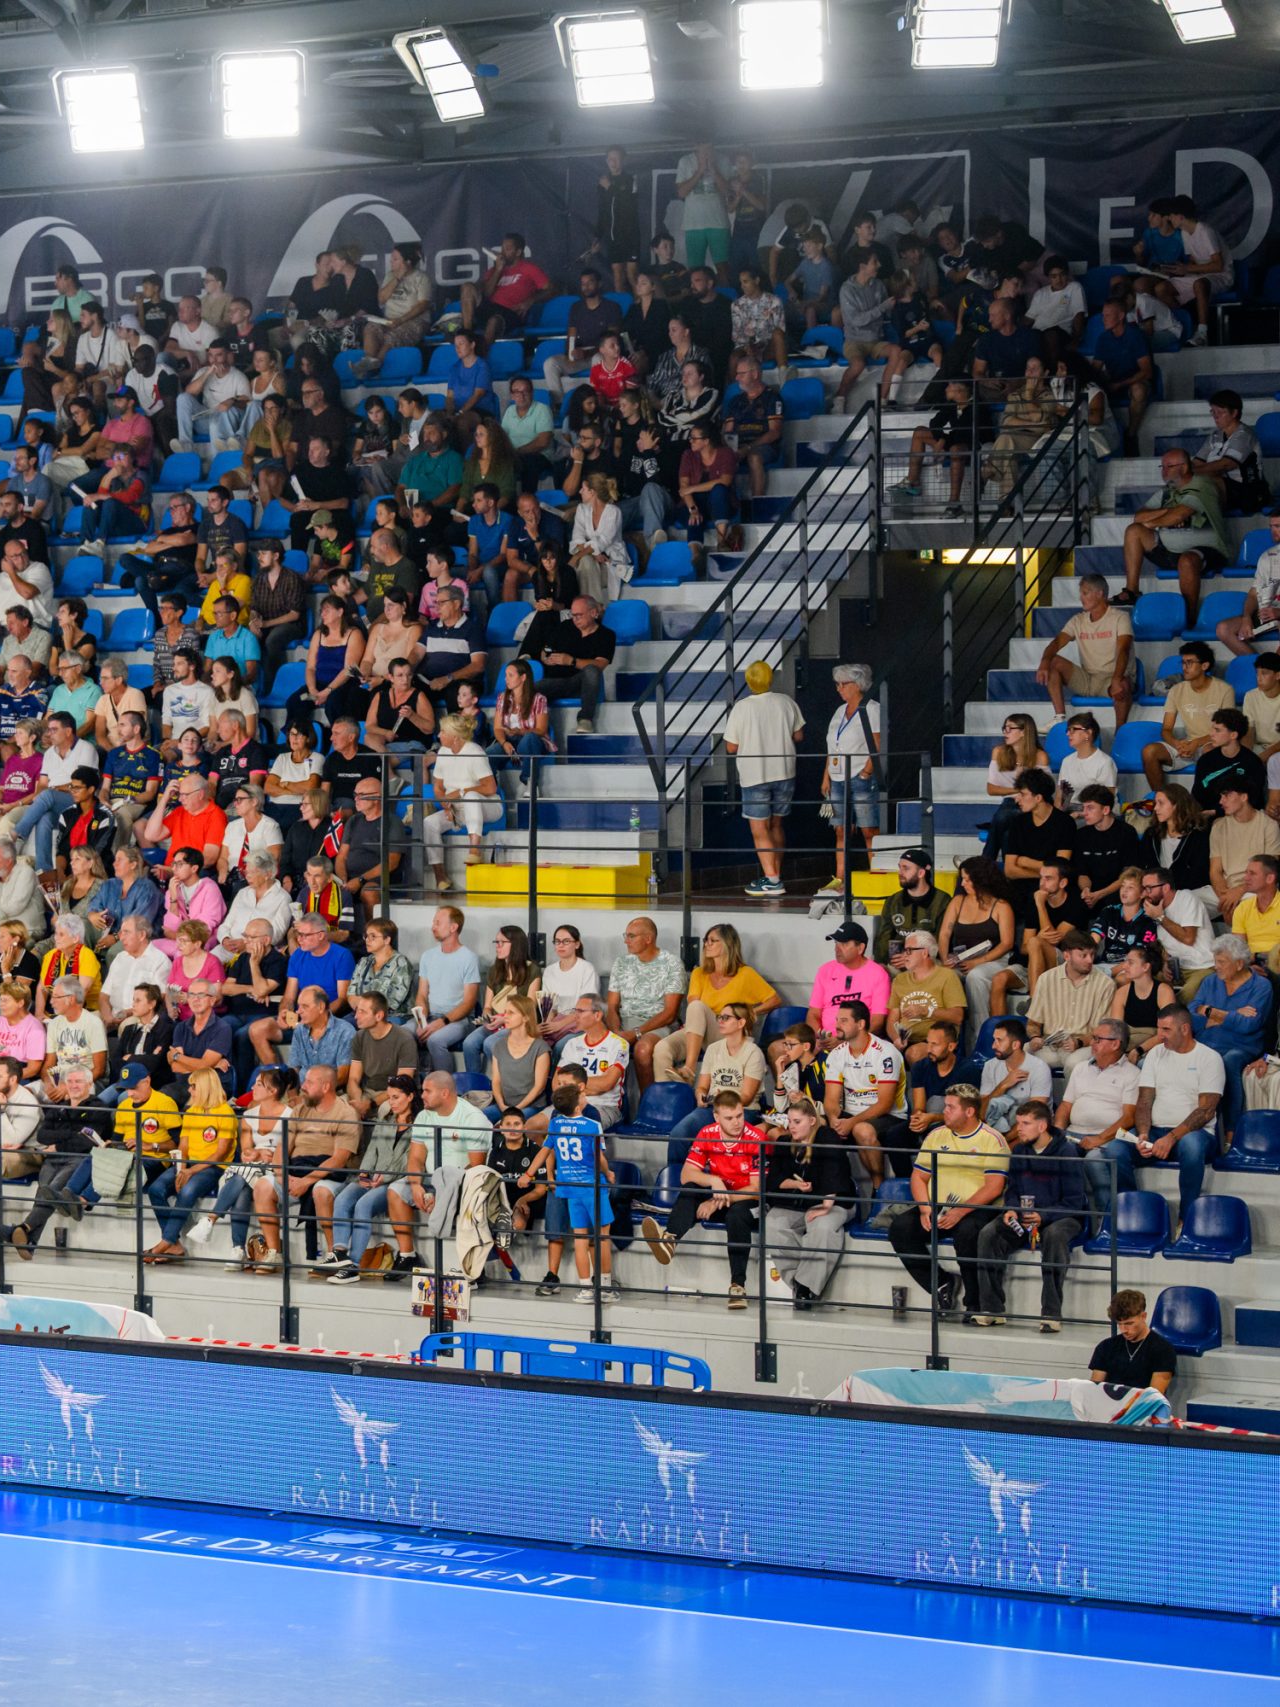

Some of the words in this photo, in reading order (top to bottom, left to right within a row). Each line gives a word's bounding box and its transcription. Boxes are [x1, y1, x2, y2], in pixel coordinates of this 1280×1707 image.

[582, 1057, 597, 1074] 24
[557, 1137, 583, 1161] 83
[24, 1440, 125, 1462] SAINT
[314, 1468, 422, 1492] SAINT
[615, 1499, 733, 1526] SAINT
[137, 1529, 207, 1546] LE
[942, 1532, 1070, 1560] SAINT
